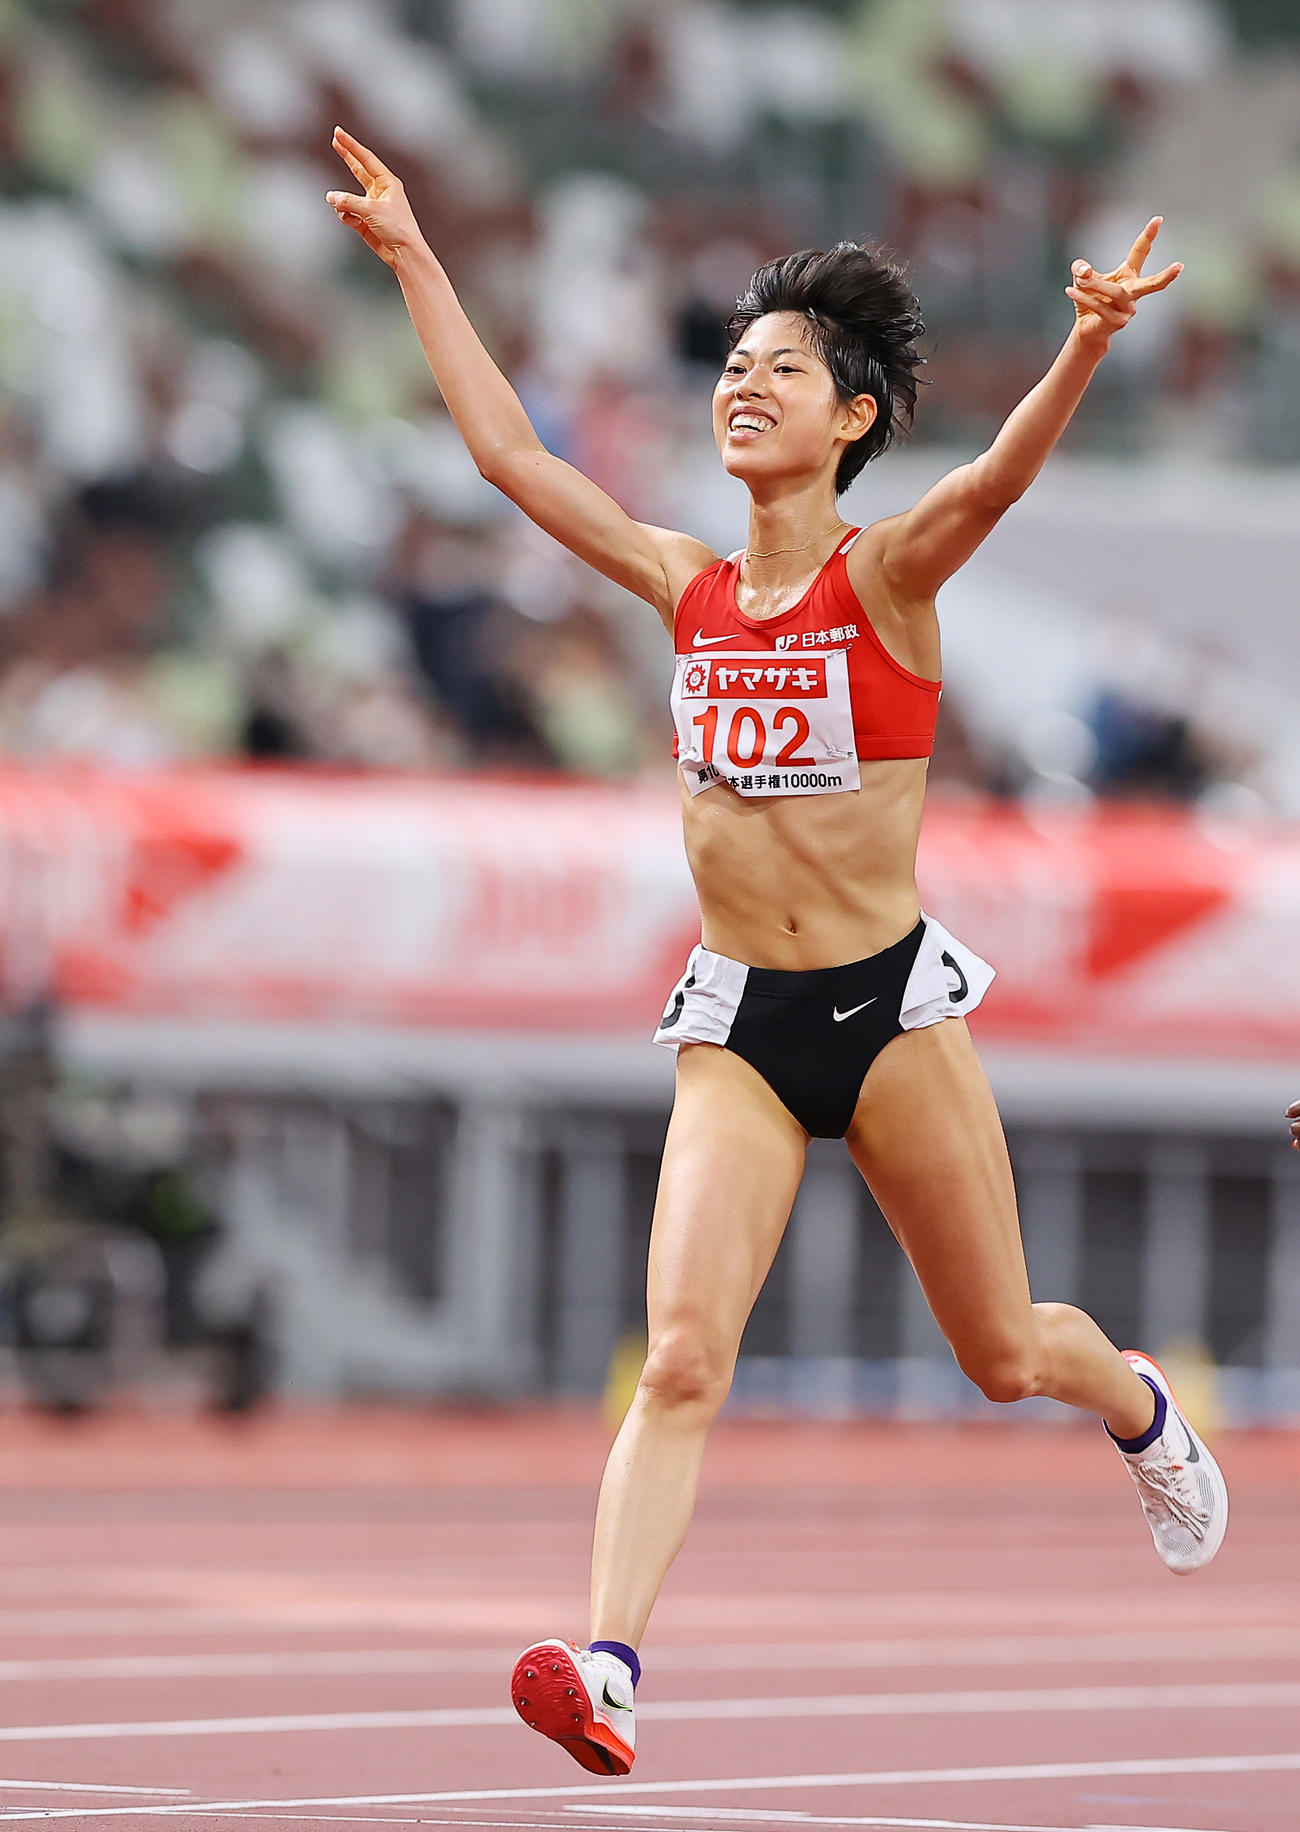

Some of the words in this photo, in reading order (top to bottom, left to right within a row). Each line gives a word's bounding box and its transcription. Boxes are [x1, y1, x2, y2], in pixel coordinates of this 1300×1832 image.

[802, 624, 860, 647] 日本郵政
[715, 667, 818, 691] ヤマザキ
[693, 705, 817, 768] 102
